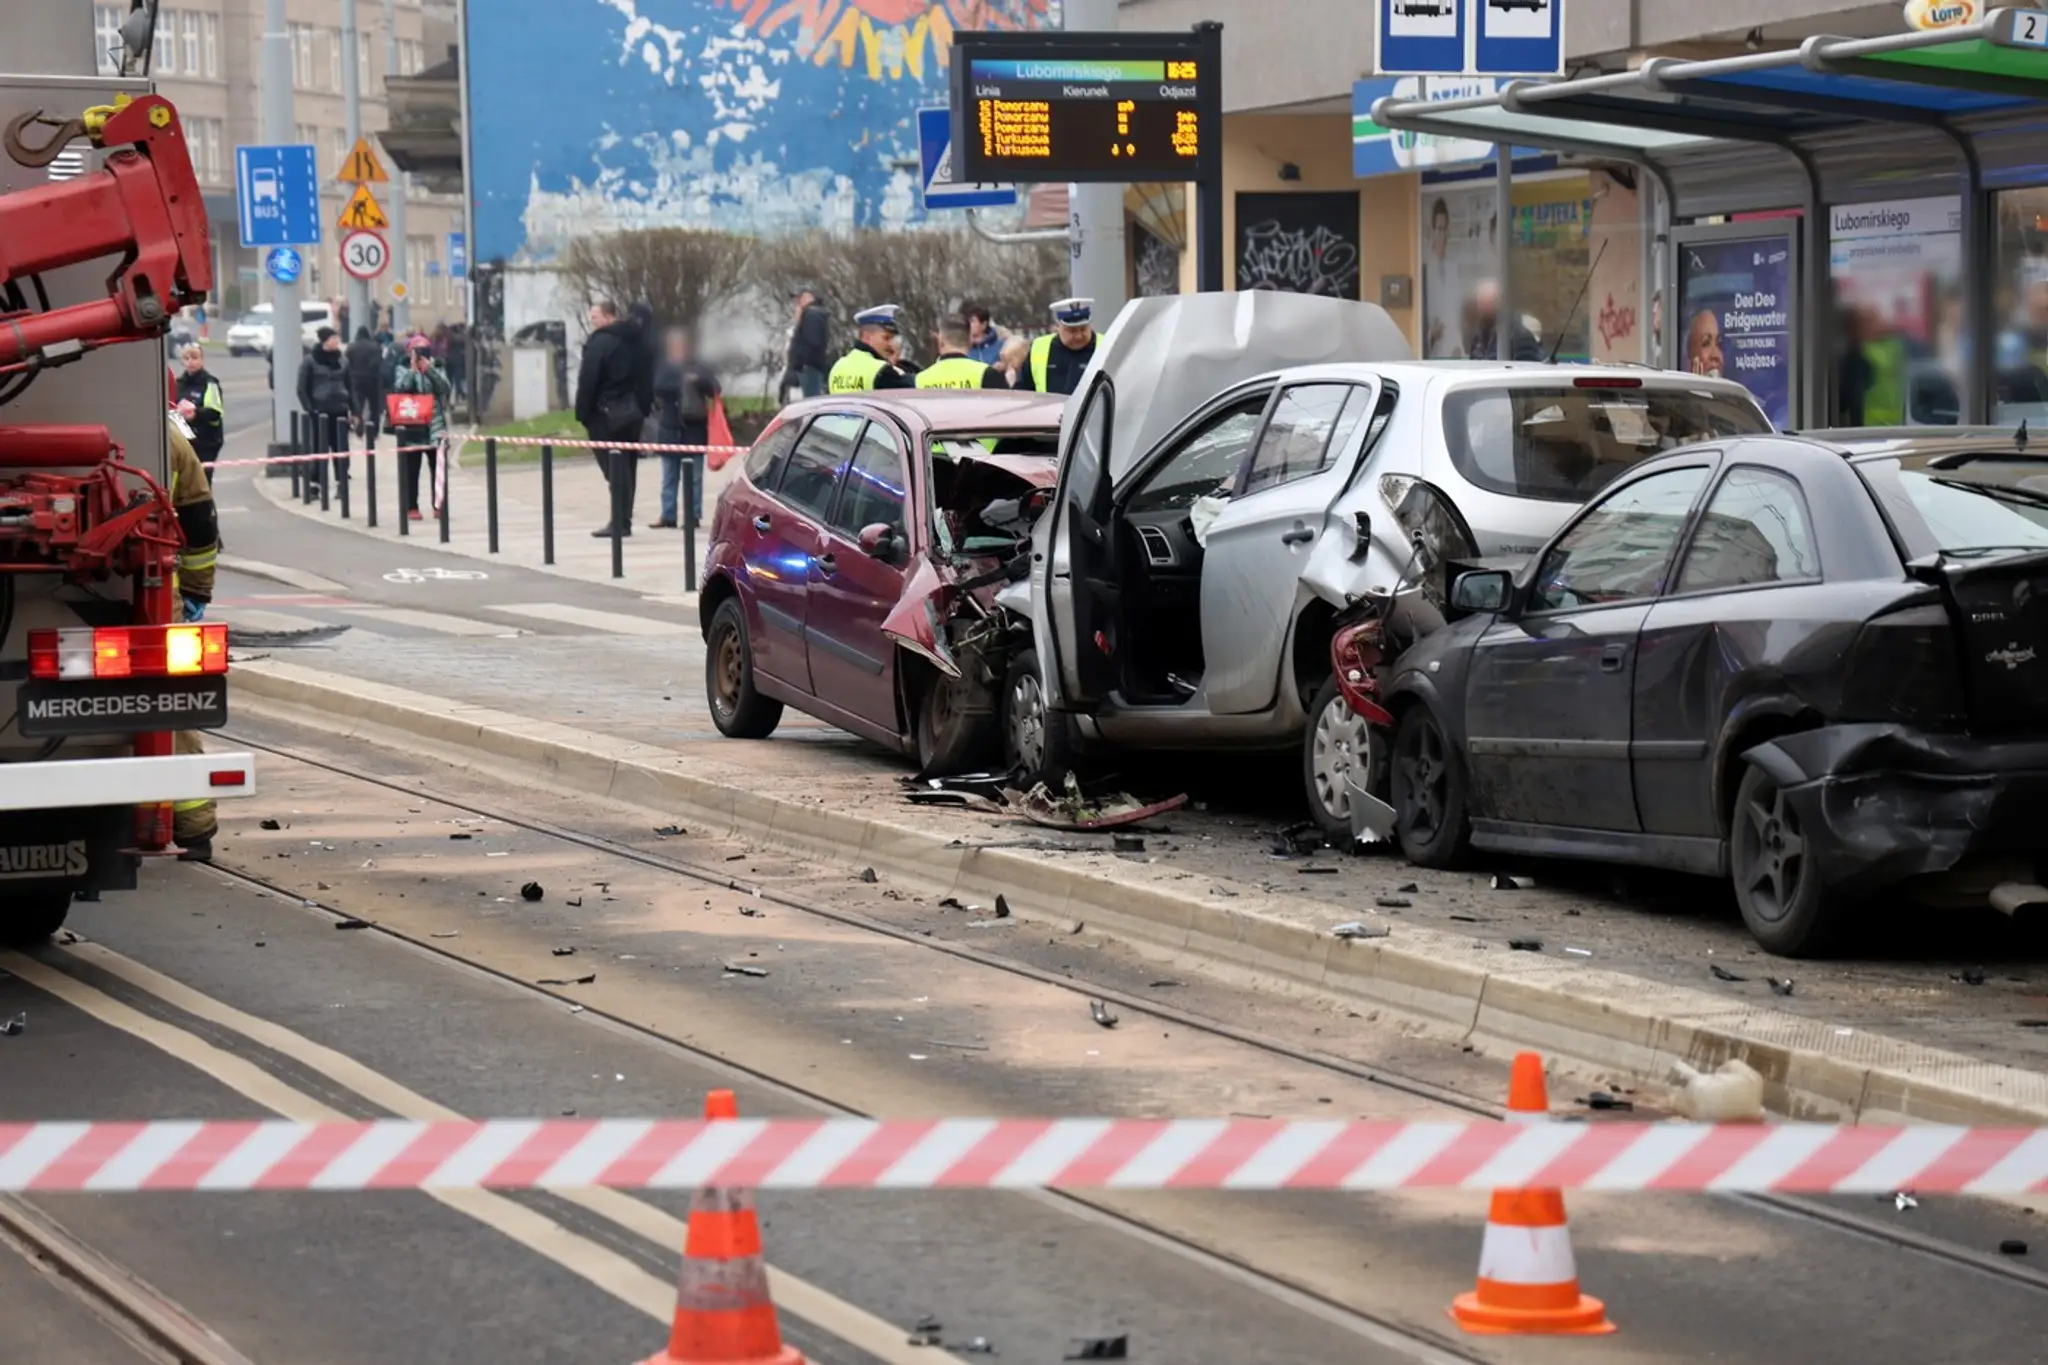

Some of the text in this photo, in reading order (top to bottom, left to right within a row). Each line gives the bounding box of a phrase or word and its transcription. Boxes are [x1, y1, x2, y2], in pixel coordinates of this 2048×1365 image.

[2024, 15, 2036, 40] 2
[1016, 63, 1122, 83] Lubomirskiego
[975, 84, 1197, 100] Linia Kierunek Odjazd
[254, 205, 279, 218] BUS
[1834, 208, 1910, 231] Lubomirskiego
[350, 243, 380, 267] 30
[1734, 291, 1776, 309] Dee Dee
[1724, 311, 1787, 332] Bridgewater
[832, 376, 865, 391] POLICJA
[28, 691, 218, 719] MERCEDES-BENZ
